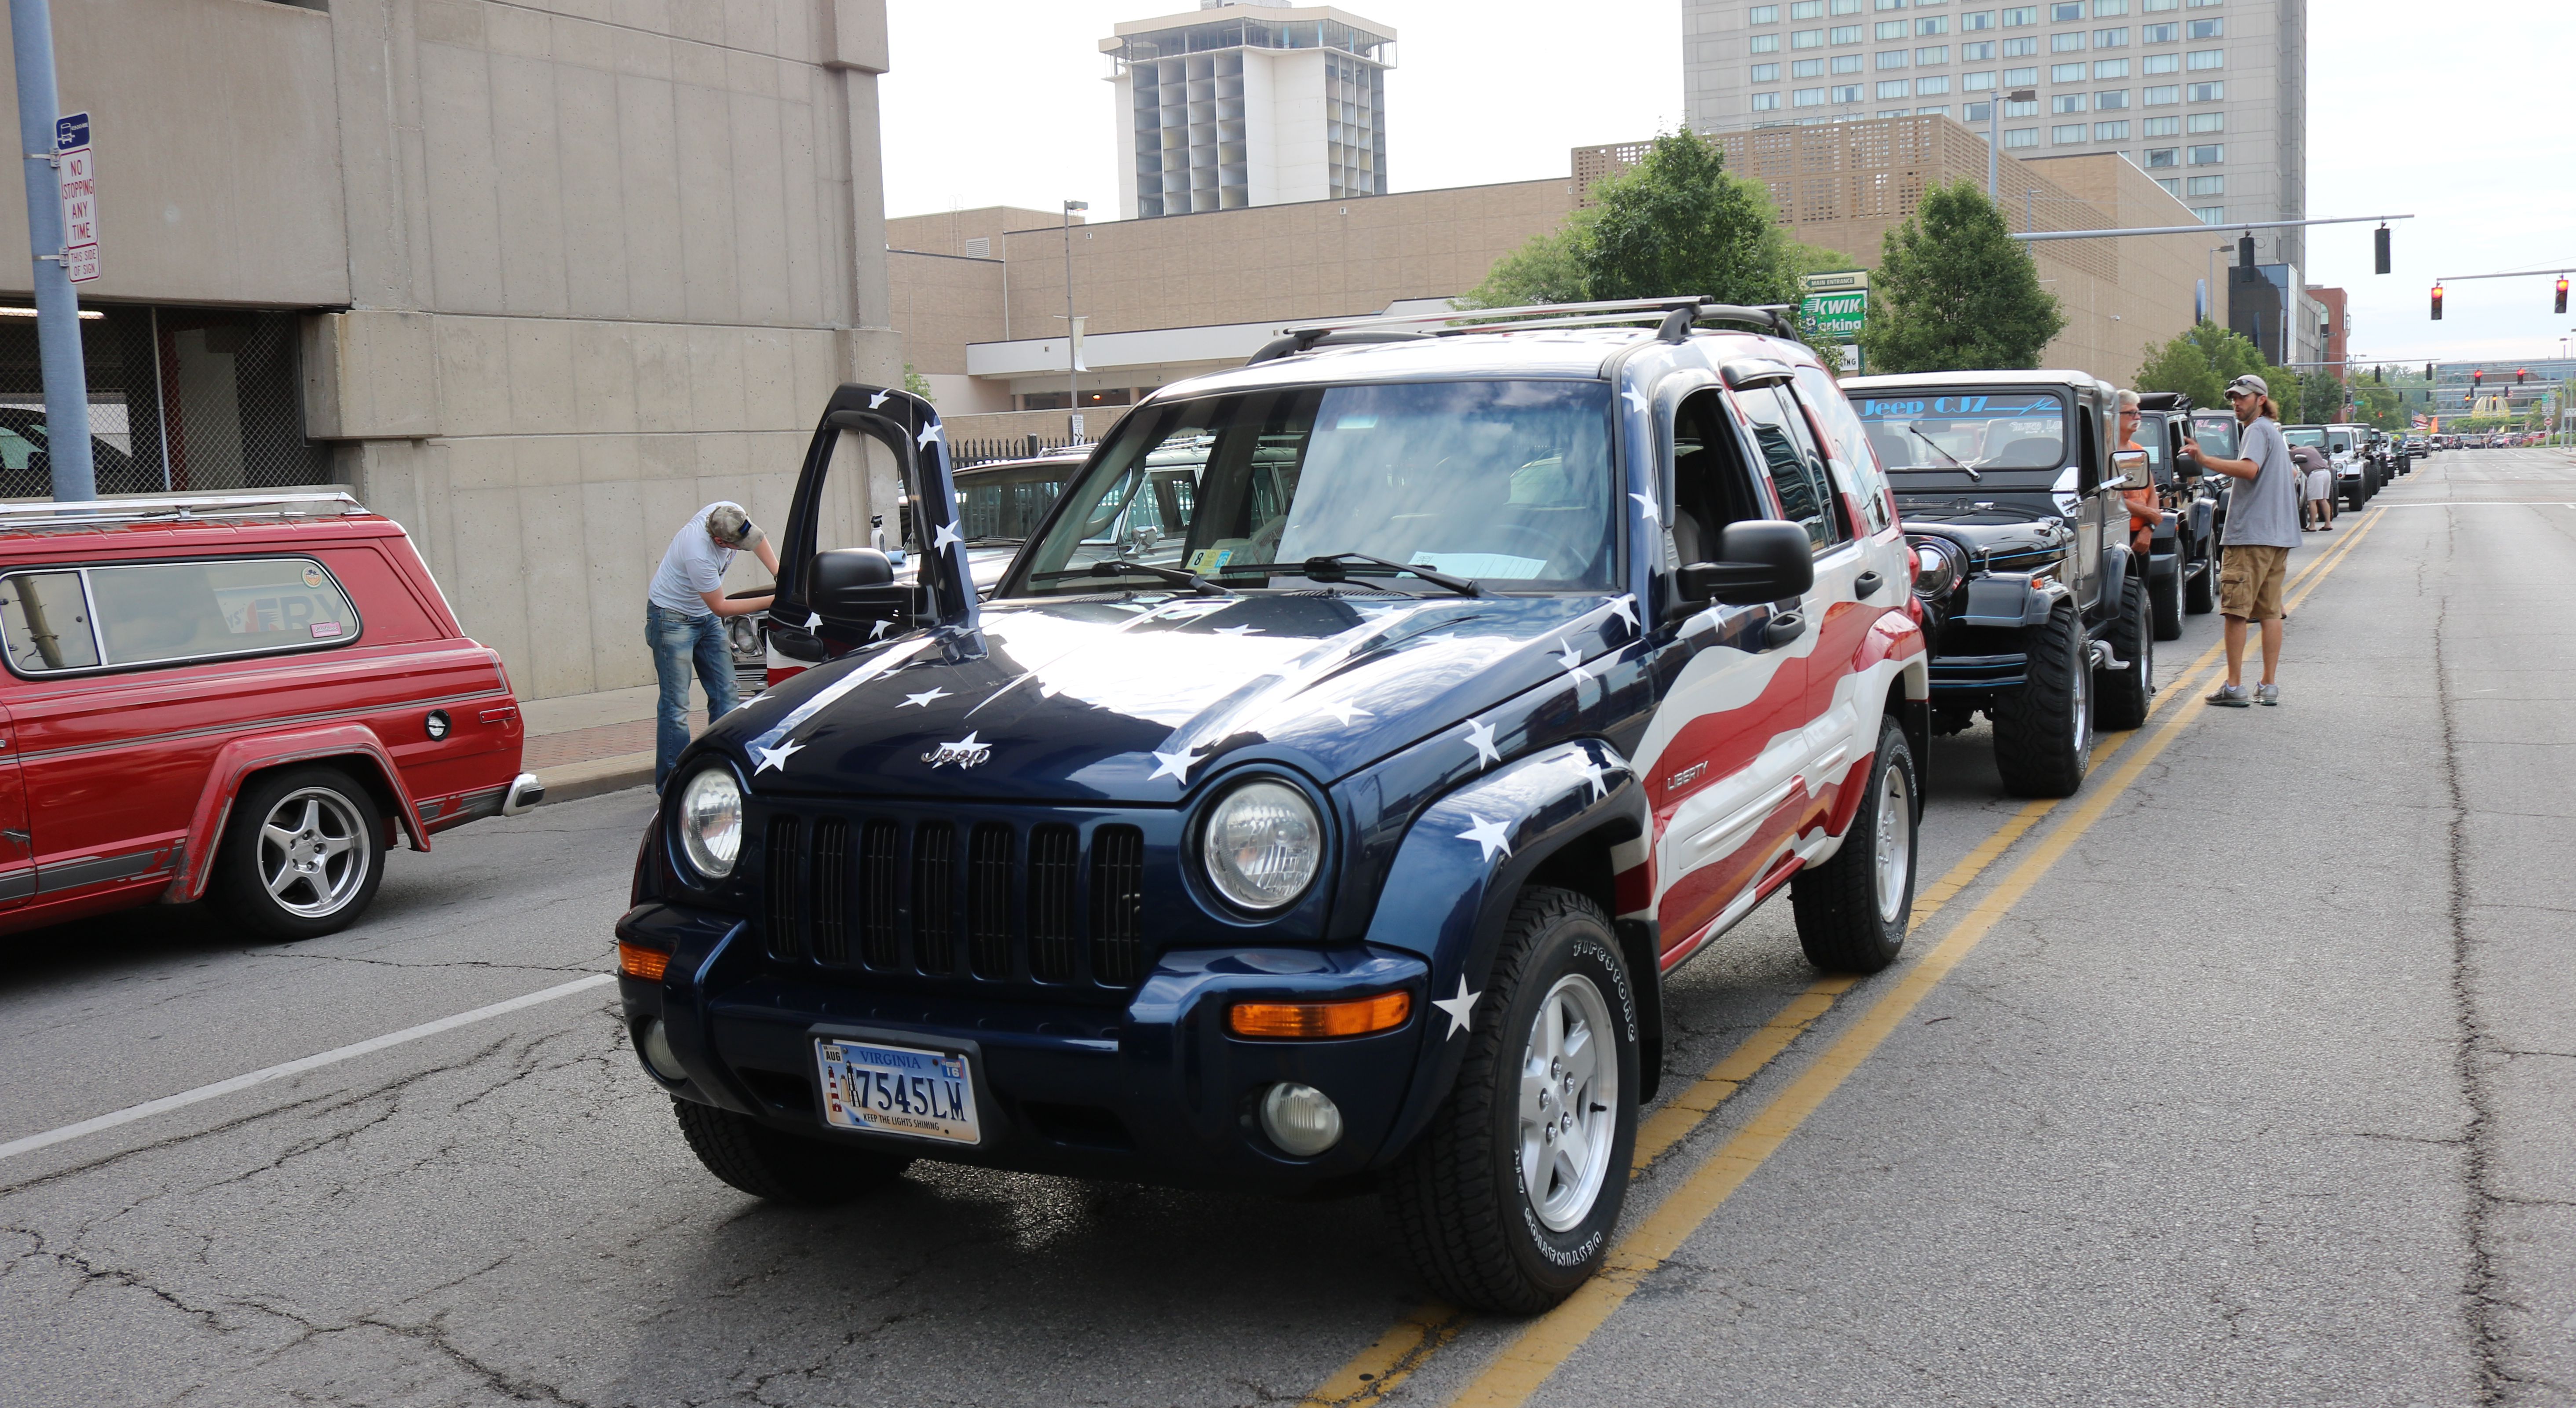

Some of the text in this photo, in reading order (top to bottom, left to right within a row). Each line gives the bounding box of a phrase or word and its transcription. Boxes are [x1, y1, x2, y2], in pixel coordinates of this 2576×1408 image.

[70, 159, 82, 177] NO
[63, 179, 93, 200] STOPPING
[72, 201, 88, 220] ANY
[72, 222, 91, 241] TIME
[71, 249, 96, 263] THIS SIDE
[74, 263, 95, 277] OF SIGN
[1858, 396, 1988, 416] Jeep CJ7
[1194, 552, 1204, 565] 8
[1216, 555, 1228, 567] 16
[921, 745, 990, 767] Jeep
[1667, 760, 1709, 791] LIBERTY
[826, 1051, 841, 1061] AUG
[860, 1051, 922, 1069] VIRGINIA
[946, 1067, 960, 1077] 16
[856, 1070, 967, 1122] 7545LM
[863, 1113, 940, 1131] KEEP THE LIGHTS SHINING
[1524, 1207, 1603, 1267] DESTINATION
